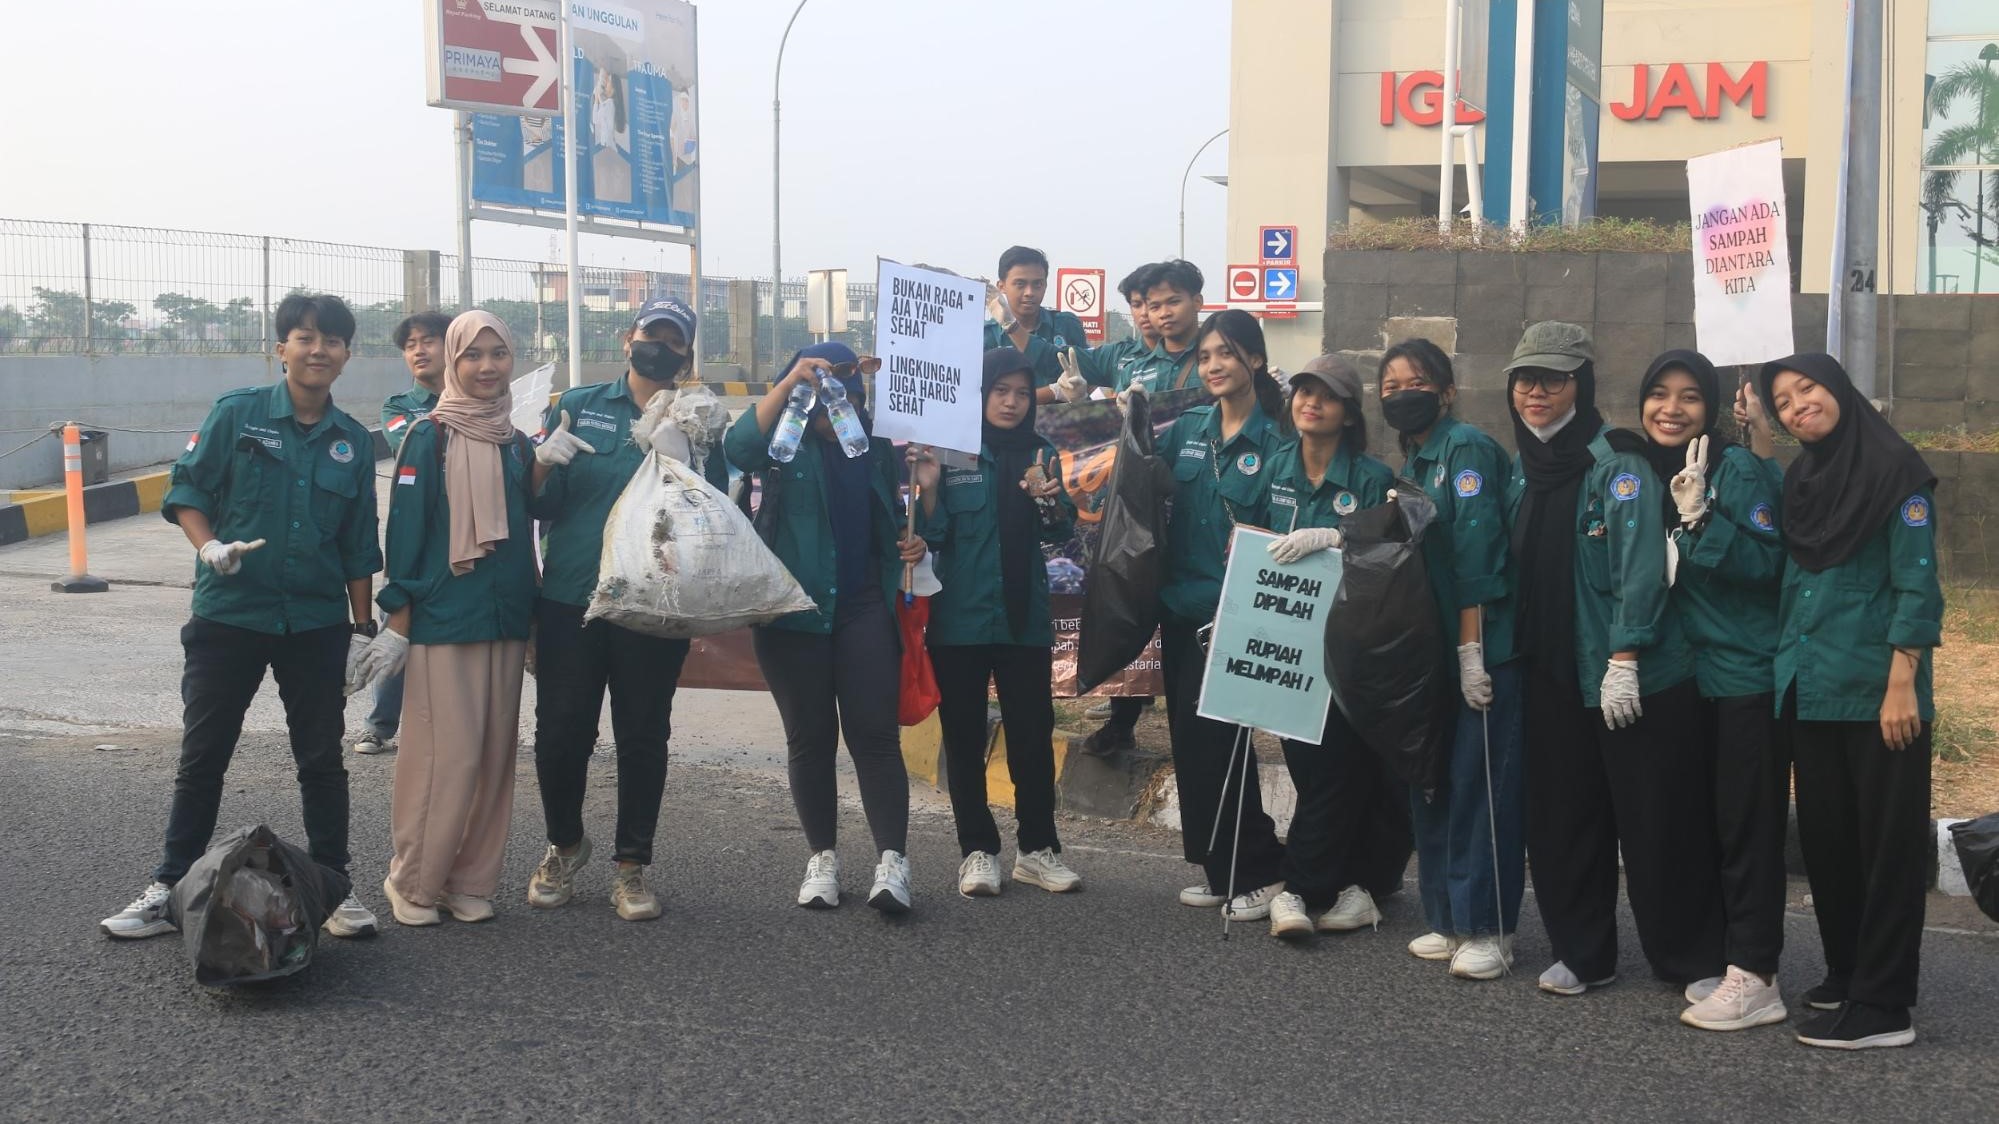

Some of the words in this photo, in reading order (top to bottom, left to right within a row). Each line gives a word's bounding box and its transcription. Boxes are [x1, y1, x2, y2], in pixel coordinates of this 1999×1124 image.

[484, 2, 521, 15] SELAMAT
[524, 8, 556, 21] DATANG
[572, 4, 585, 18] AN
[587, 8, 638, 31] UNGGULAN
[445, 50, 501, 70] PRIMAYA
[1609, 61, 1769, 121] JAM
[1696, 206, 1748, 231] JANGAN
[1751, 200, 1780, 220] ADA
[1709, 227, 1767, 250] SAMPAH
[1706, 250, 1775, 274] DIANTARA
[893, 277, 931, 302] BUKAN
[935, 286, 963, 310] RAGA
[1725, 276, 1756, 295] KITA
[1851, 270, 1874, 293] 24
[891, 297, 911, 317] AJA
[916, 302, 944, 324] YANG
[891, 316, 927, 339] SEHAT
[890, 355, 960, 386] LINGKUNGAN
[889, 374, 916, 396] JUGA
[920, 380, 956, 404] HARUS
[889, 393, 925, 417] SEHAT
[1256, 568, 1322, 598] SAMPAH
[1253, 592, 1314, 620] DIPILAH
[1246, 638, 1302, 666] RUPIAH
[1226, 658, 1303, 690] MELIMPAH
